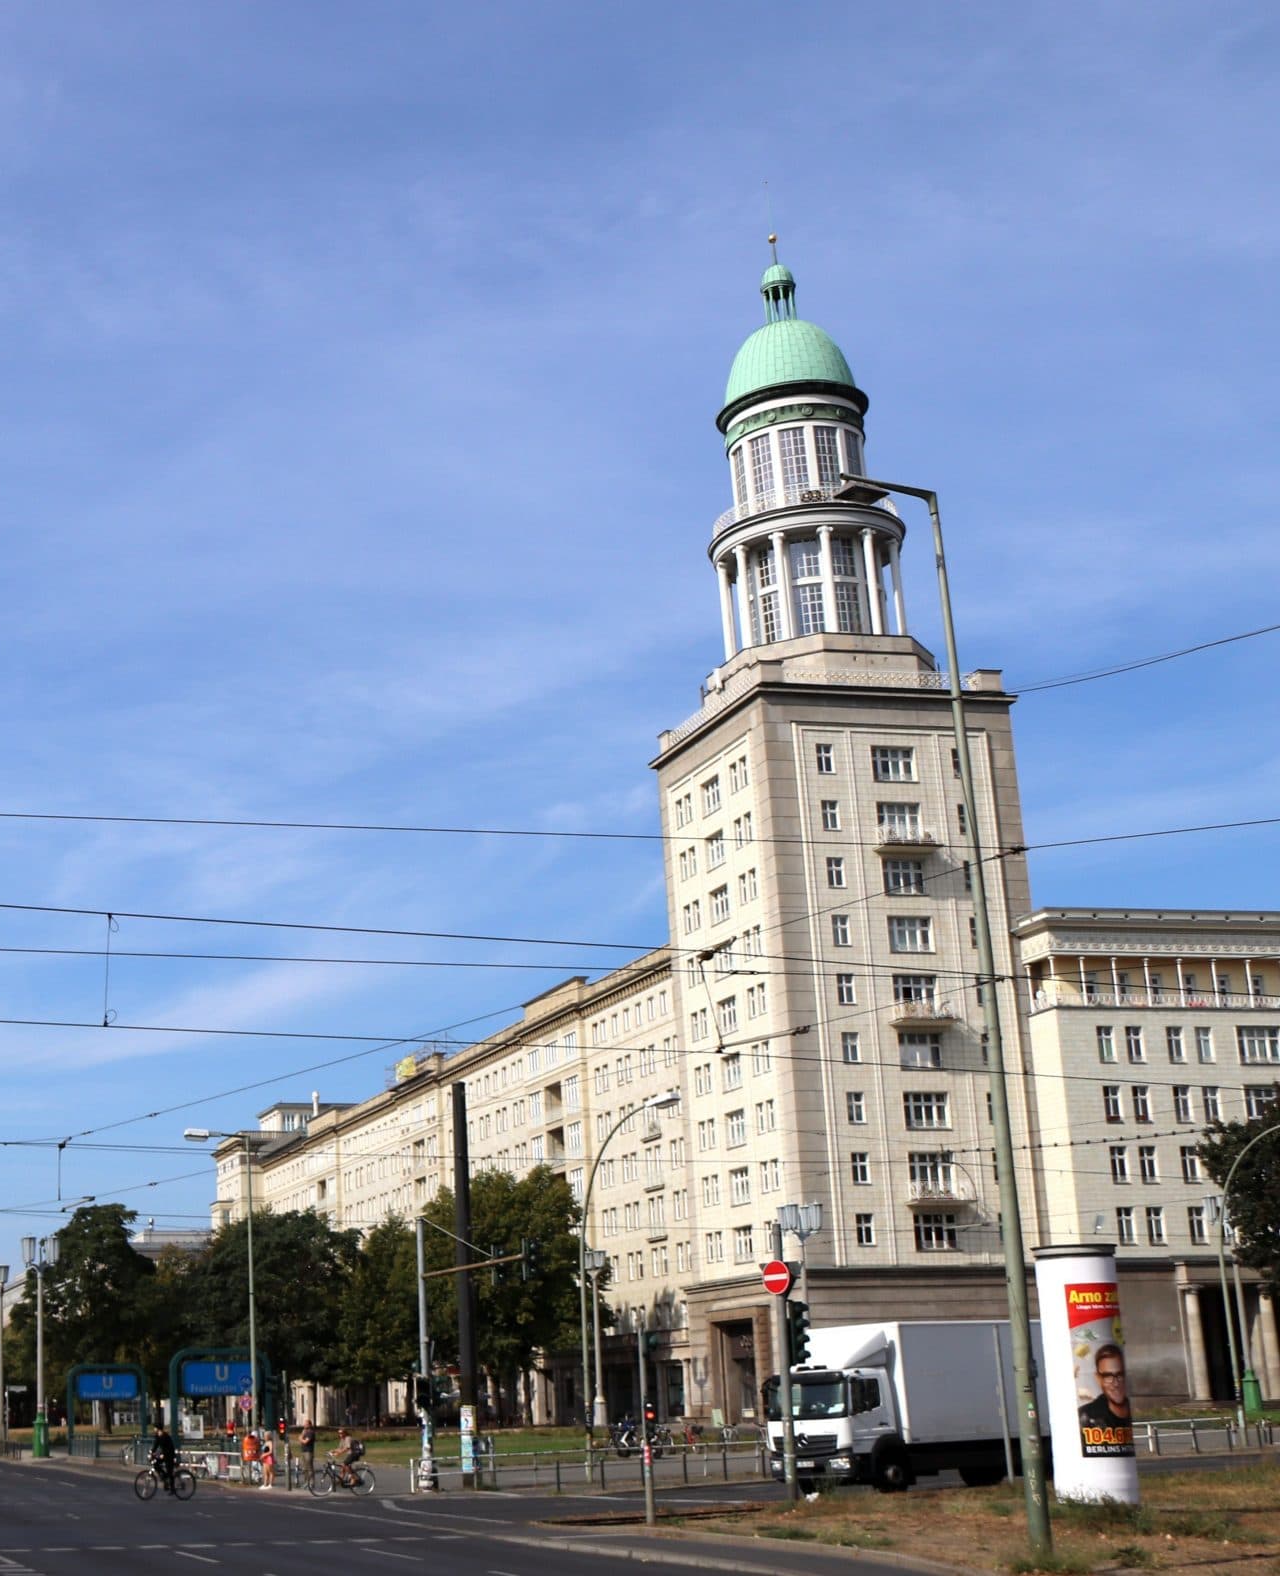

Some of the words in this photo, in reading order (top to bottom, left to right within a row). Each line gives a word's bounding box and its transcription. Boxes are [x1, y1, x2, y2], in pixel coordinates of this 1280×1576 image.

[1069, 1289, 1102, 1303] Arno
[215, 1363, 229, 1381] U
[1086, 1445, 1121, 1453] BERLINS
